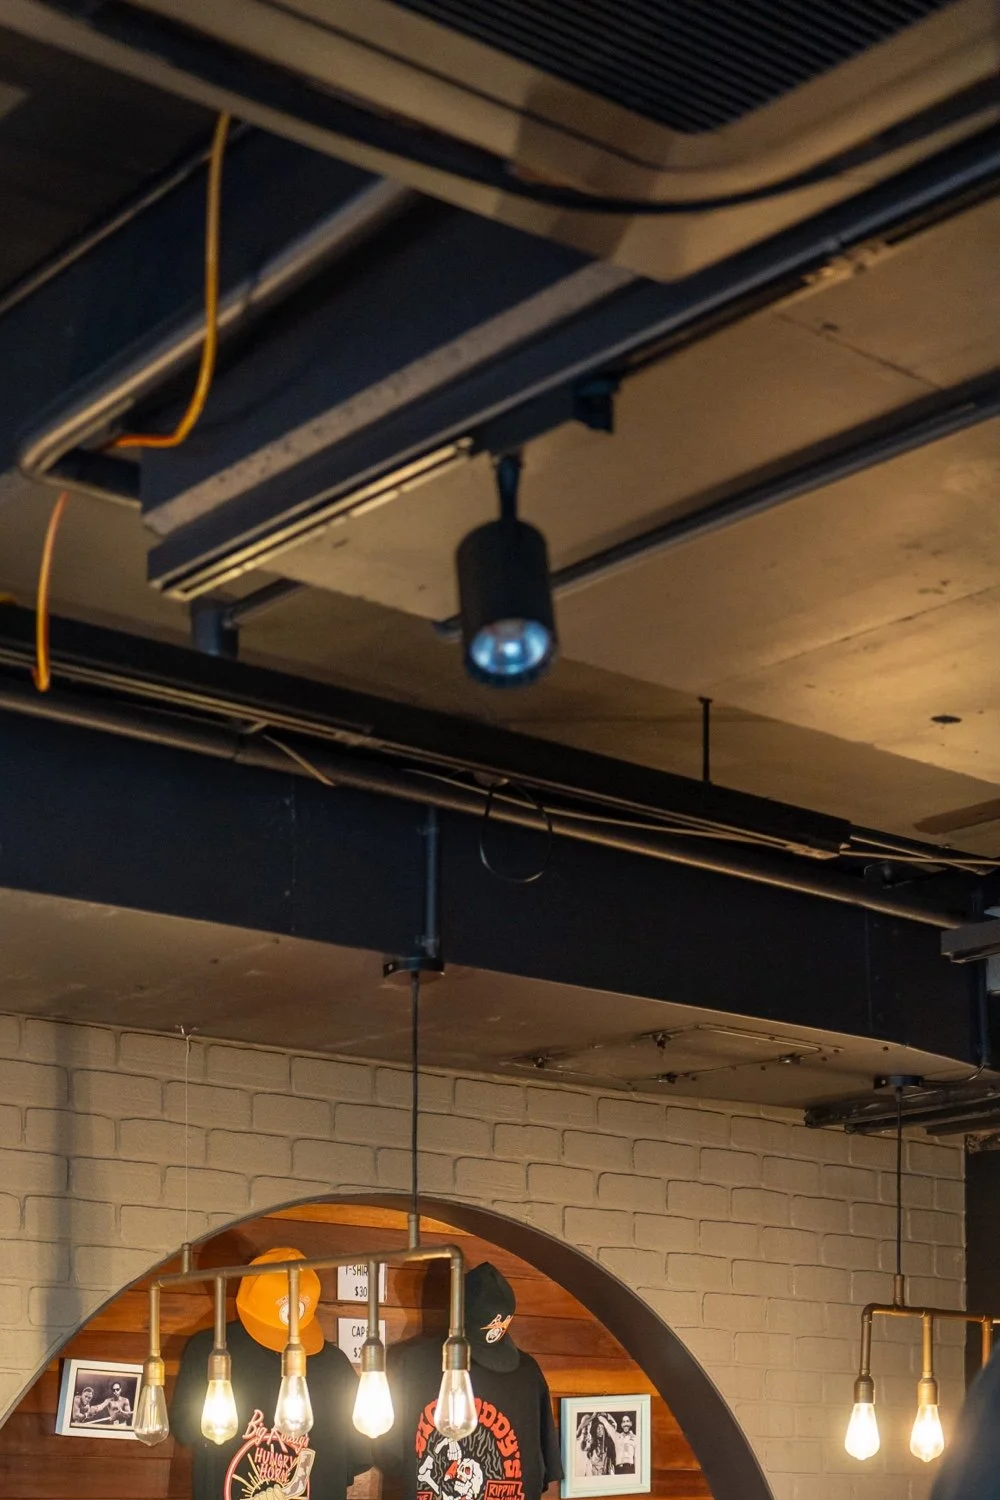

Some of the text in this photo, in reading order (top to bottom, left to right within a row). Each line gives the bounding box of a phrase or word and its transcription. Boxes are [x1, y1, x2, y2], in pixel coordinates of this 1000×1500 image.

[354, 1286, 368, 1298] $30
[352, 1325, 368, 1338] CAP
[242, 1409, 268, 1447] Big
[254, 1447, 297, 1471] HUNGRY
